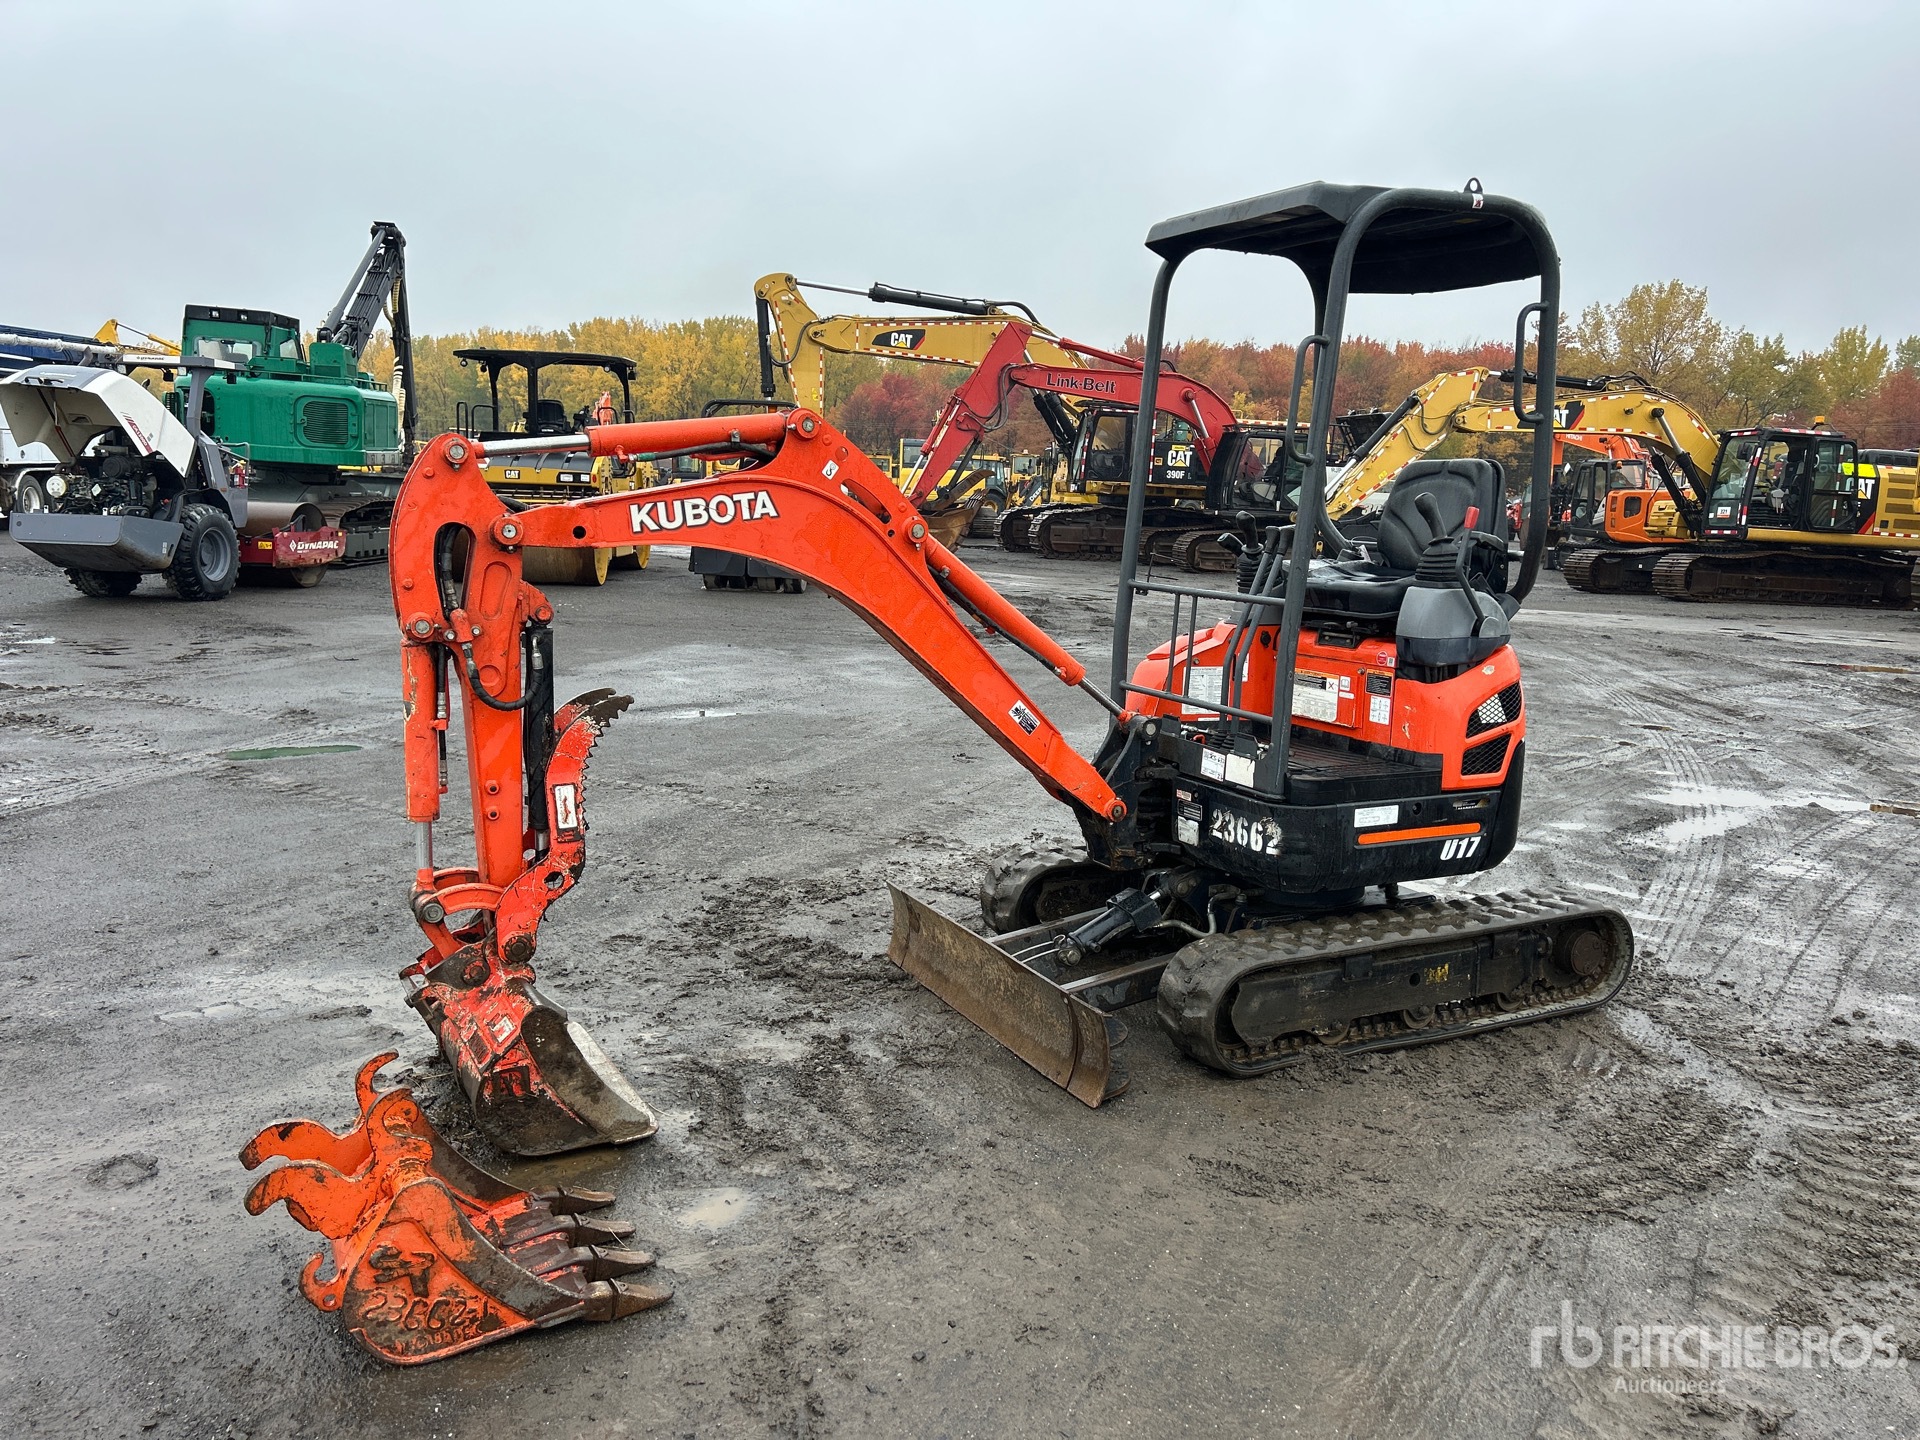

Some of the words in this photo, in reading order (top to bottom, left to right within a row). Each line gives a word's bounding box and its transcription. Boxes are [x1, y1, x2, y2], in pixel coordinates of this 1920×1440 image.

[891, 332, 913, 348] CAT
[1047, 373, 1116, 393] Link-Belt
[1553, 409, 1569, 428] AT
[1167, 450, 1193, 467] CAT
[505, 470, 520, 479] CAT
[1166, 470, 1186, 479] 390F
[630, 491, 778, 533] KUBOTA
[297, 541, 339, 549] DYNAPAC
[1209, 809, 1282, 856] 23662
[1440, 837, 1481, 861] U17
